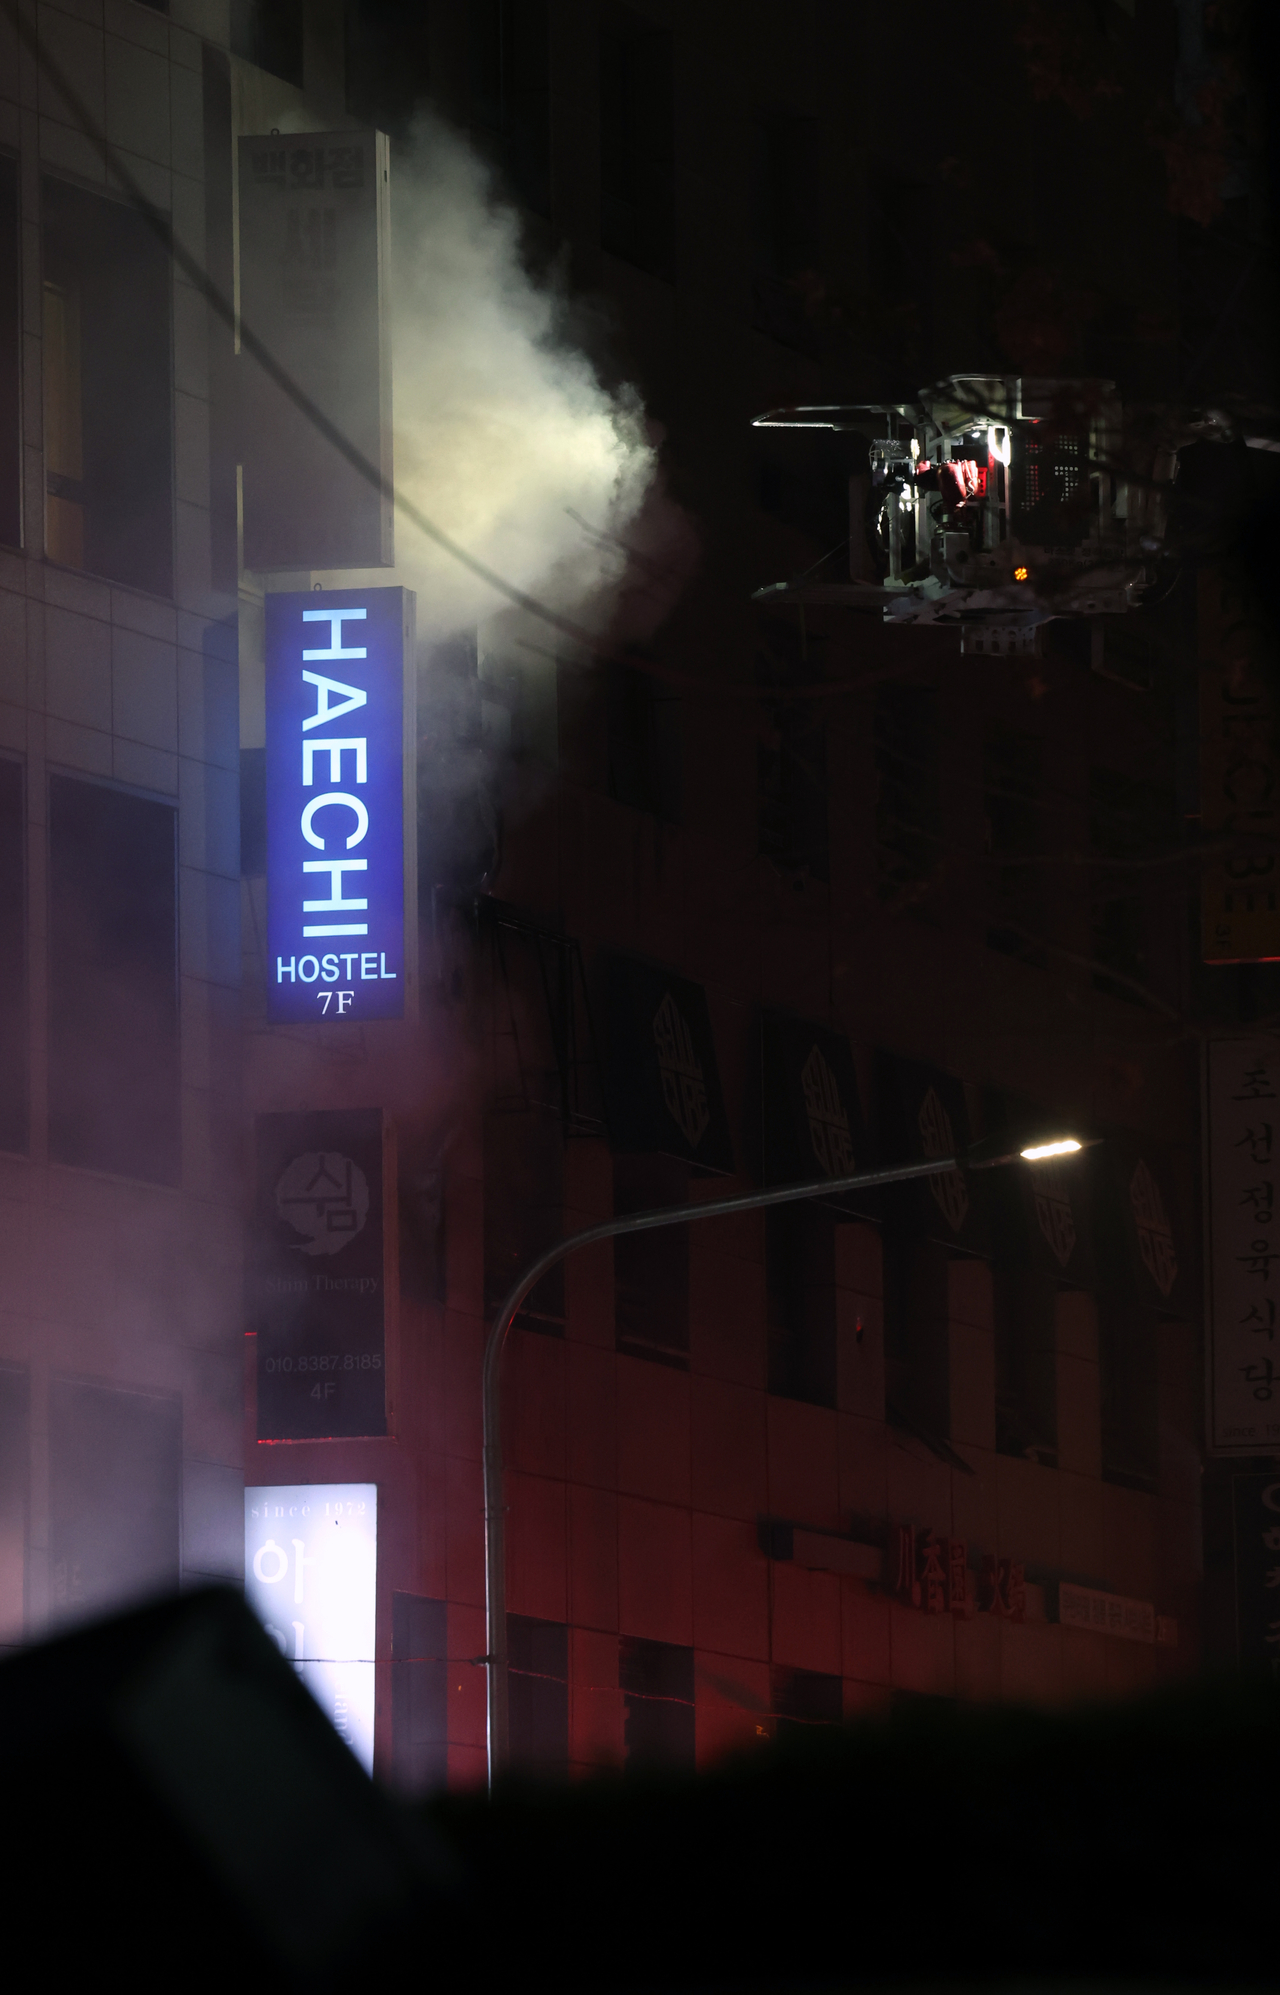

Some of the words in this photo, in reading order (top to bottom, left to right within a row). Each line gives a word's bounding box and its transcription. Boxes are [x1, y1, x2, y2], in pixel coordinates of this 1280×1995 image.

[251, 146, 364, 190] 백화점
[300, 608, 370, 938] HAECHI
[276, 952, 397, 983] HOSTEL
[316, 990, 355, 1015] 7F
[1232, 1068, 1280, 1402] 조선정육식당
[265, 1274, 308, 1292] Shim
[312, 1274, 380, 1294] Therapy
[265, 1353, 381, 1374] 010.8387.8185
[310, 1382, 336, 1400] 4F
[1223, 1425, 1256, 1438] since
[251, 1502, 311, 1518] since
[324, 1501, 366, 1517] 1972
